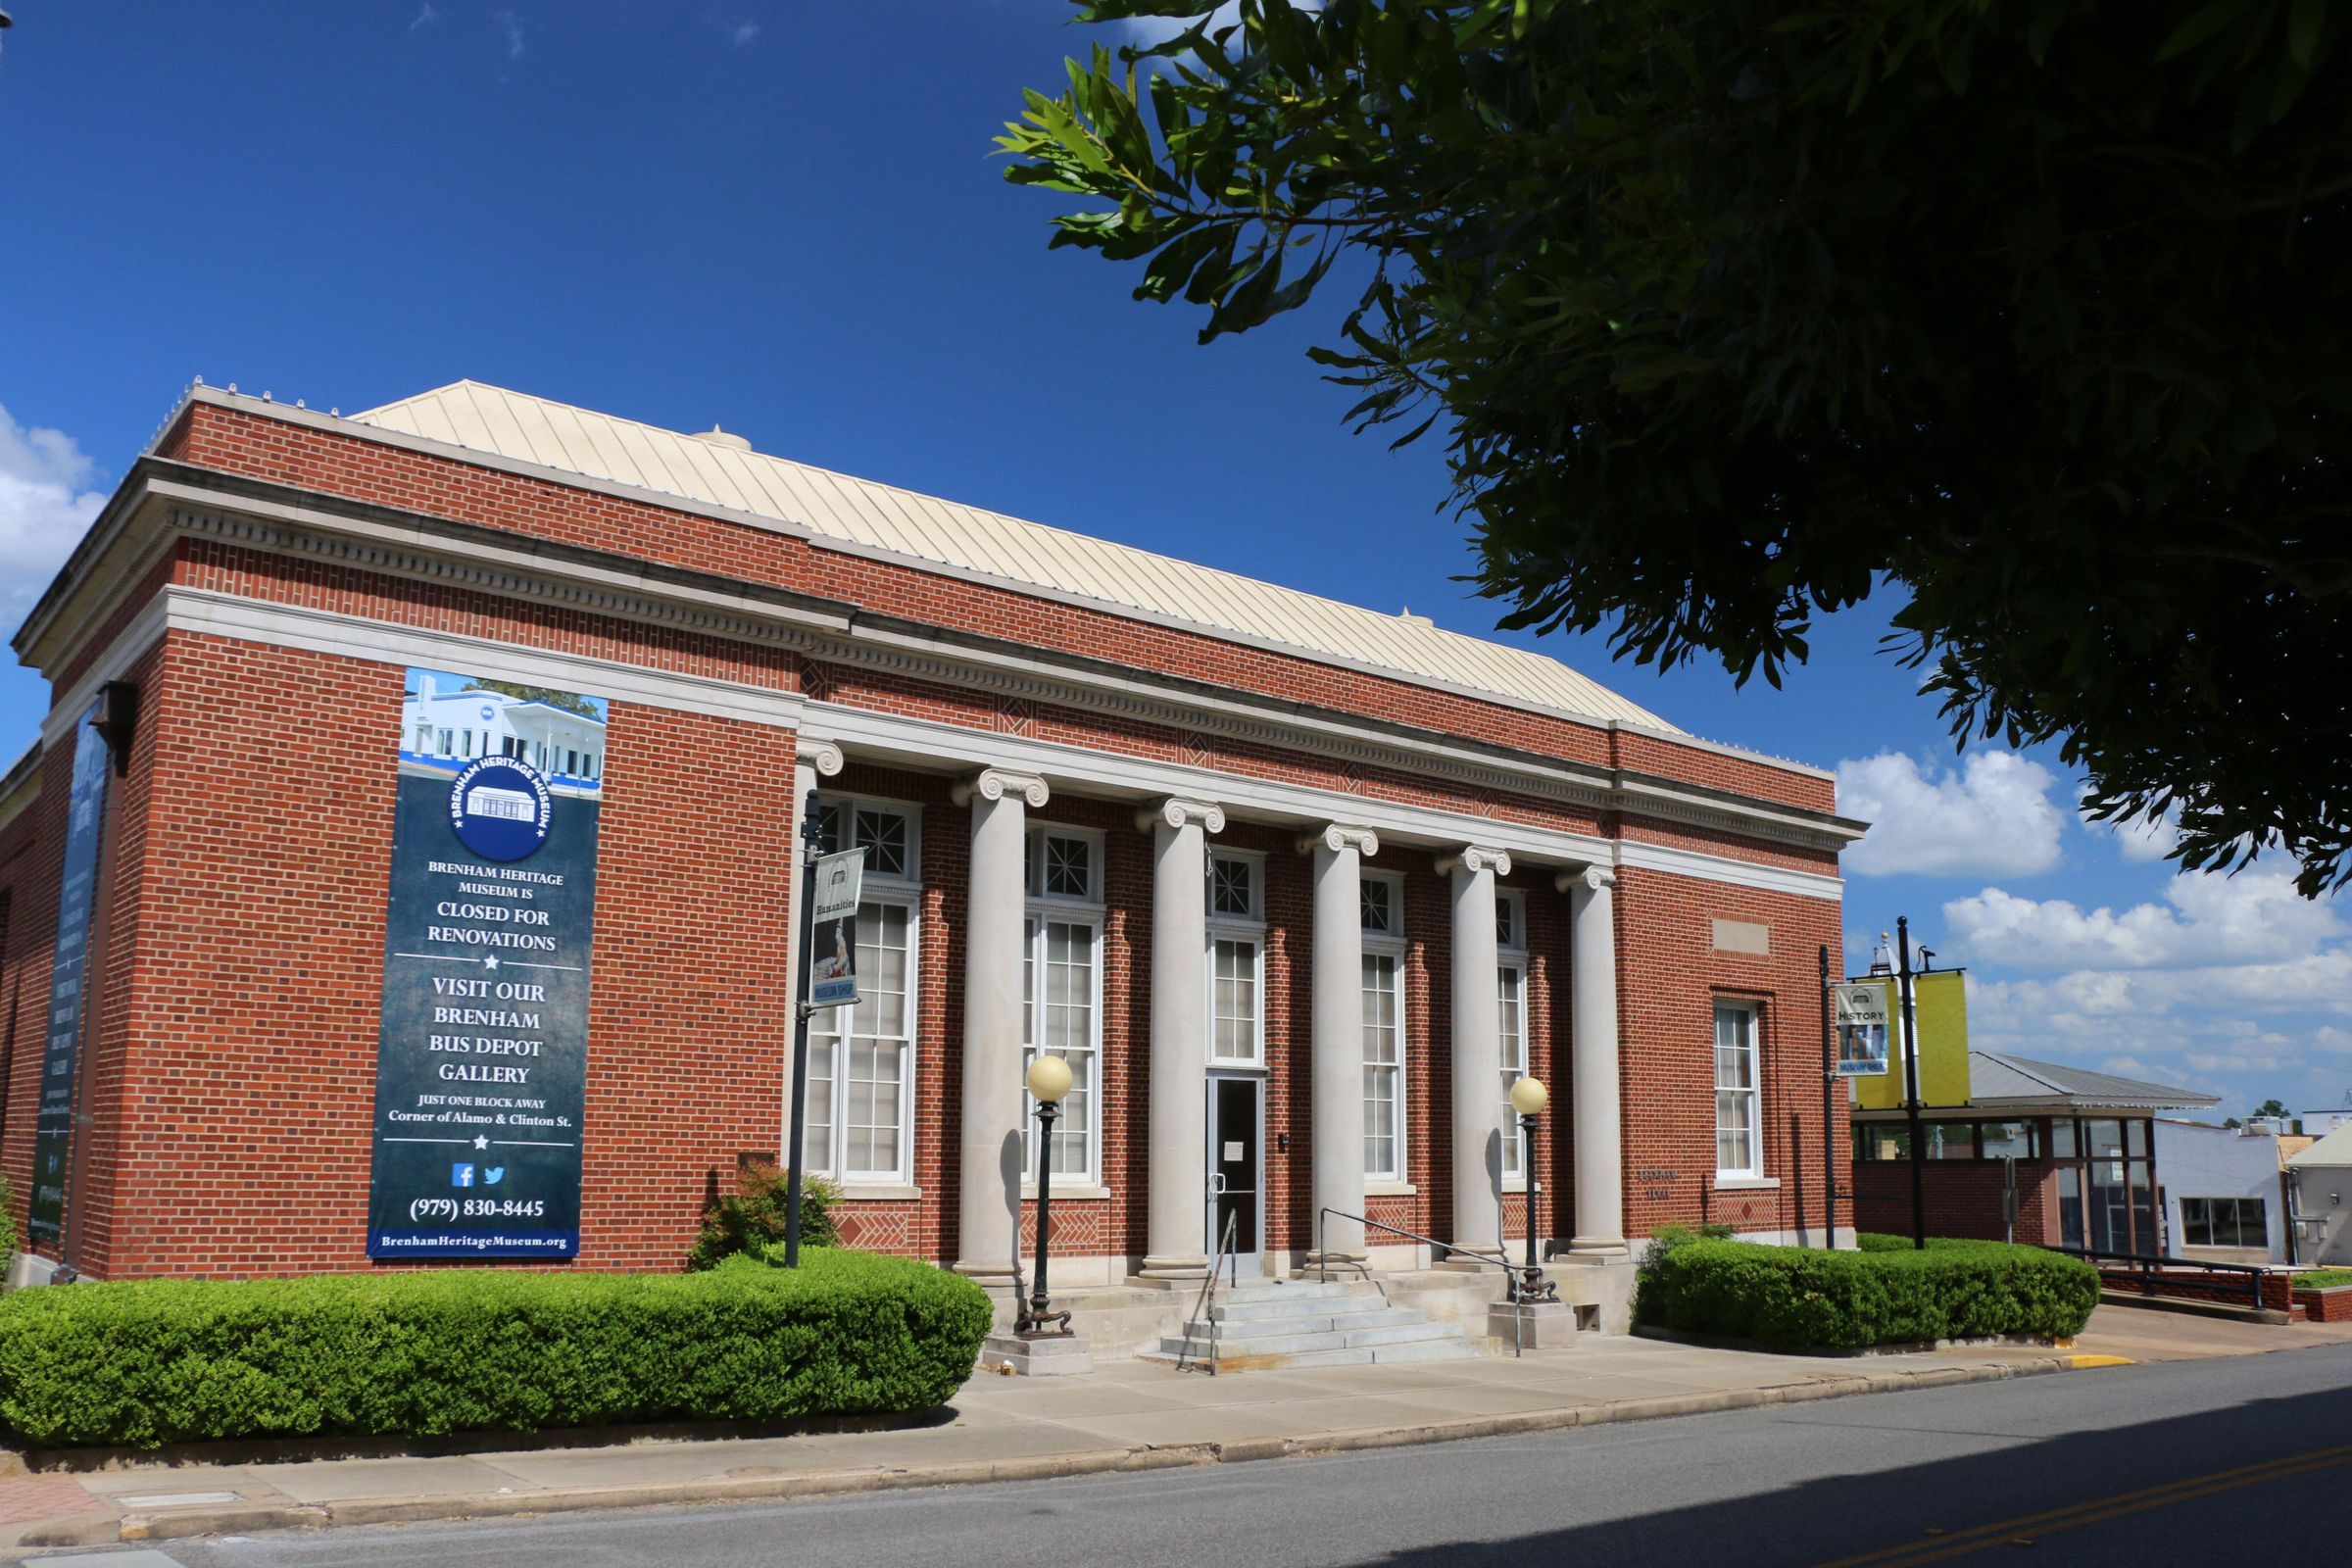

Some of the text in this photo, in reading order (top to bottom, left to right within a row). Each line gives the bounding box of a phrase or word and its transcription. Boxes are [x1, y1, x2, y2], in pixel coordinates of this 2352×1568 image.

[451, 757, 552, 829] BRENHAM HERITAGE MUSEUM
[428, 861, 564, 886] BRENHAM HERITAGE
[458, 882, 533, 900] MUSEUM IS
[437, 902, 550, 926] CLOSED FOR
[817, 899, 855, 915] Humanities
[427, 926, 556, 951] RENOVATIONS
[432, 977, 546, 1003] VISIT OUR
[433, 1006, 541, 1029] BRENHAM
[1838, 1011, 1884, 1021] HISTORY
[429, 1035, 542, 1056] BUS DEPOT
[439, 1063, 530, 1084] GALLERY
[417, 1095, 546, 1109] JUST ONE BLOCK AWAY
[388, 1110, 572, 1127] Corner of Alamo & Clinton St.
[410, 1199, 544, 1222] (979) 830-8445
[381, 1236, 567, 1250] BrenhamHeritageMuseum.org
